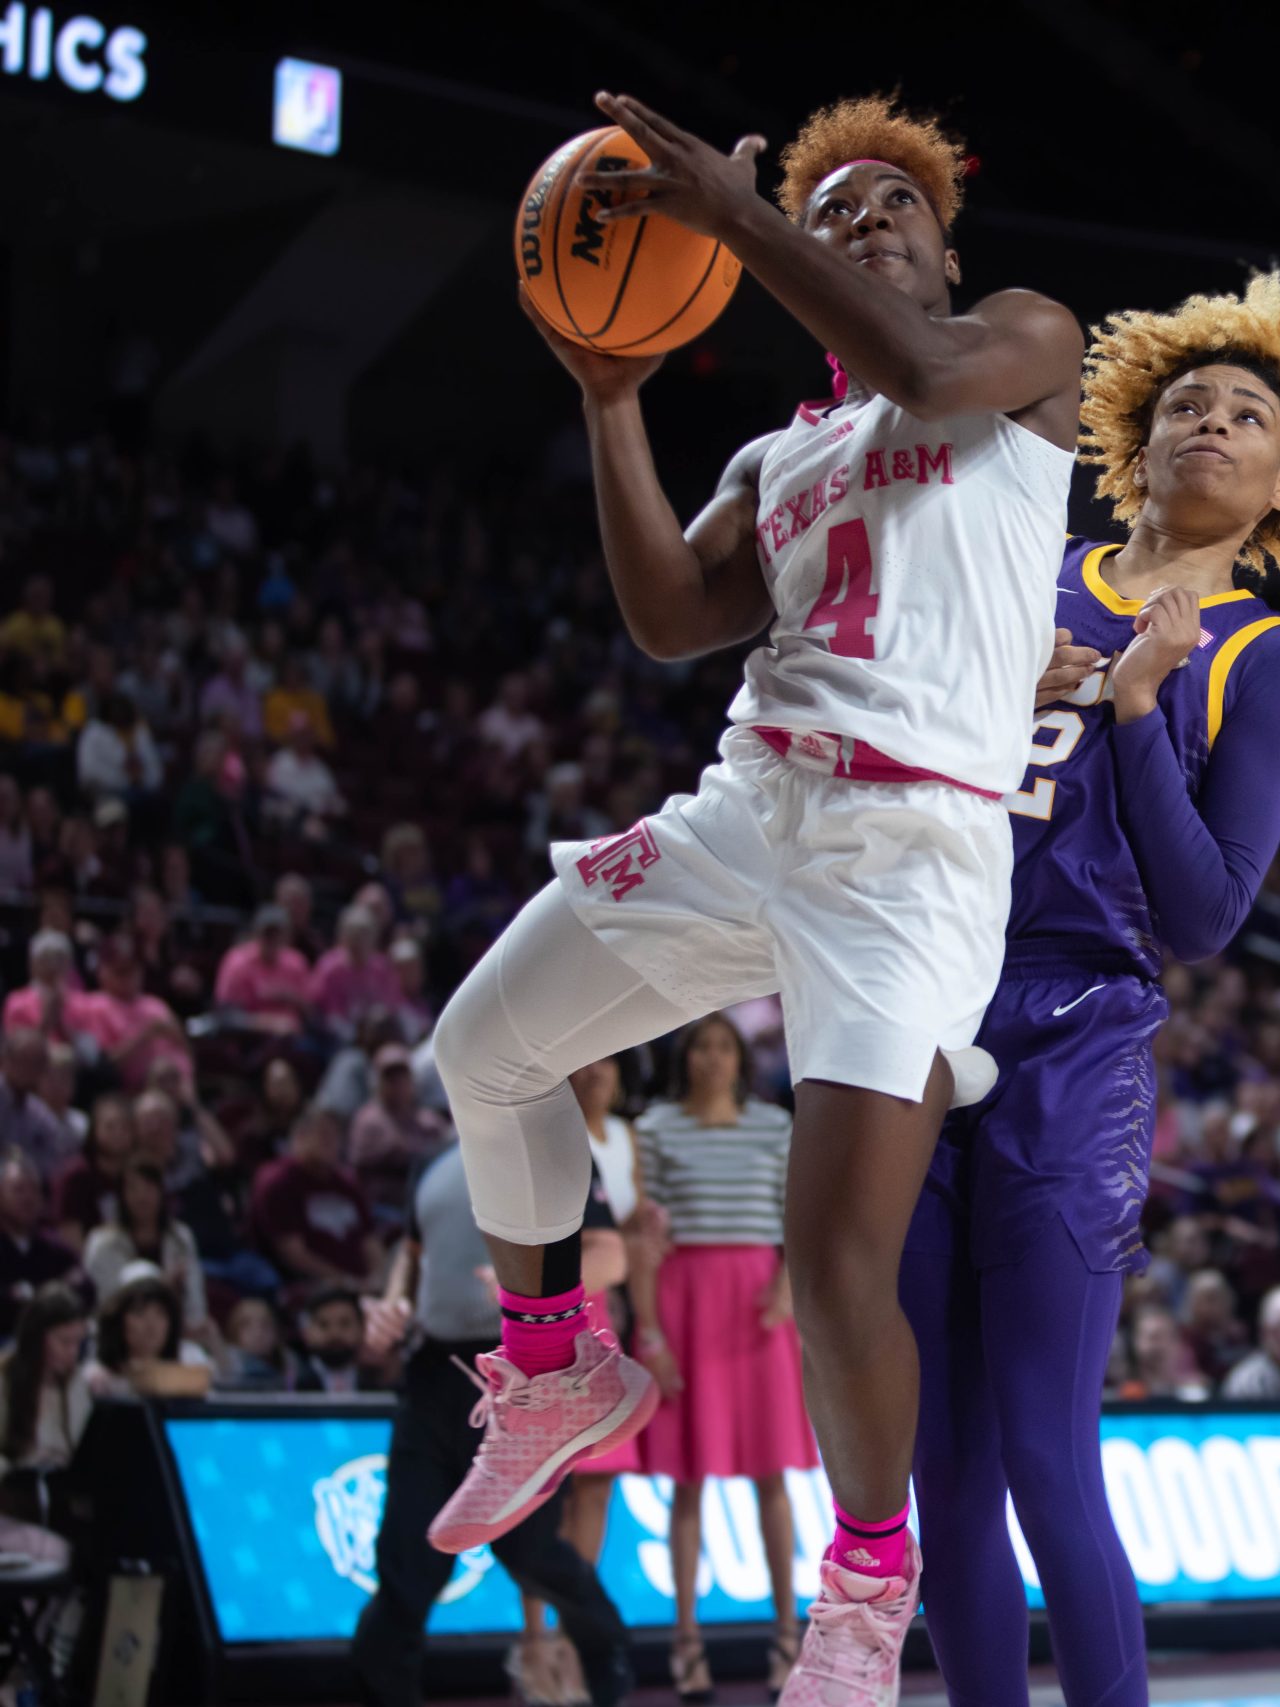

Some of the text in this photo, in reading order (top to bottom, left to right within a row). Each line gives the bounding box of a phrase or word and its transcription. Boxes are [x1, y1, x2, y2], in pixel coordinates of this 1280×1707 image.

[756, 443, 954, 565] TEXAS A&M
[803, 517, 880, 660] 4
